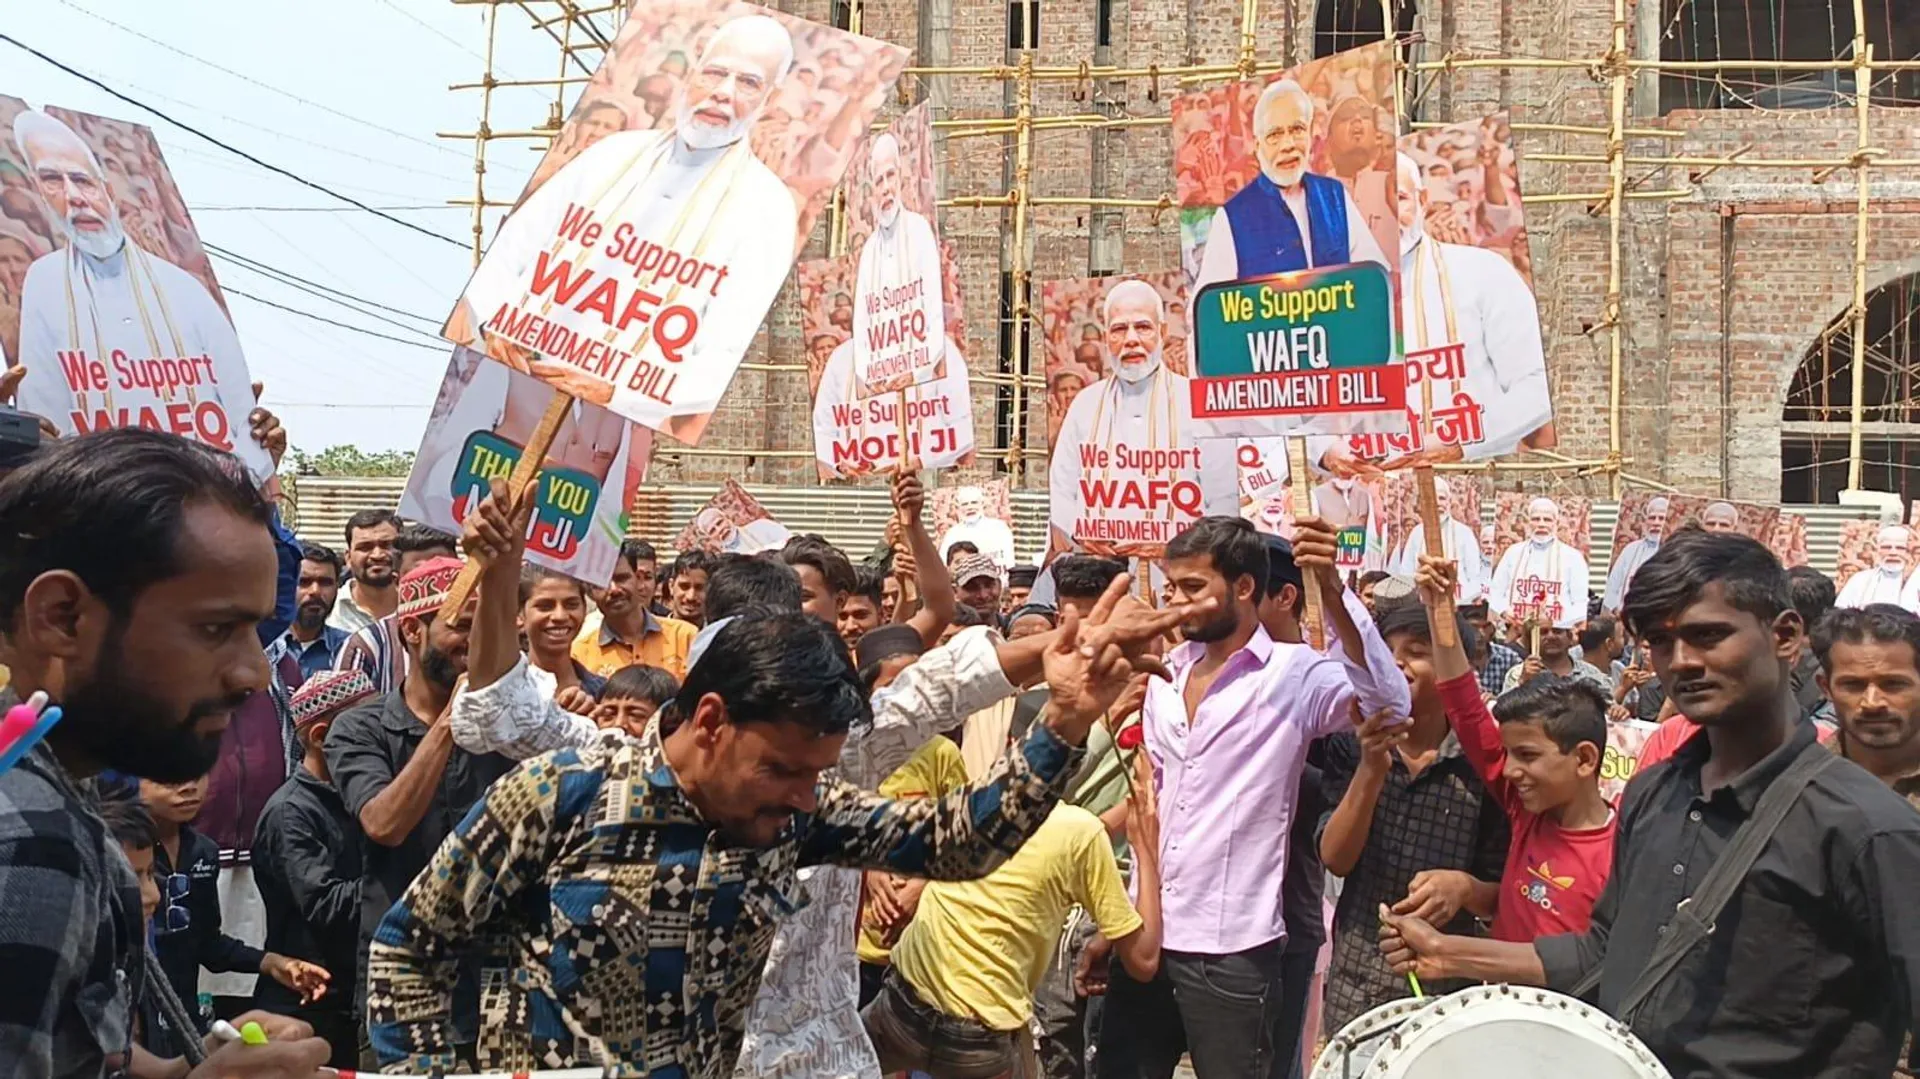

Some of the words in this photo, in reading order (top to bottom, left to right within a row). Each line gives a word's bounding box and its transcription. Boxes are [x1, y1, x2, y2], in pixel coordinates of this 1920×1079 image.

[558, 202, 602, 248] We
[605, 222, 729, 297] Support
[530, 251, 699, 363] WAFQ
[866, 292, 880, 314] We
[883, 274, 924, 312] Support
[1220, 290, 1254, 323] We
[1260, 280, 1355, 324] Support
[867, 308, 926, 352] WAFQ
[1247, 325, 1329, 373] WAFQ
[57, 350, 109, 393] We
[111, 349, 218, 398] Support
[487, 302, 633, 382] AMENDMENT
[627, 360, 679, 406] BILL
[1205, 374, 1331, 411] AMENDMENT
[1338, 371, 1386, 405] BILL
[832, 403, 862, 427] We
[1431, 392, 1484, 444] जी
[931, 427, 957, 453] JI
[1080, 443, 1109, 469] We
[1116, 443, 1200, 475] Support
[470, 445, 543, 481] THA
[547, 475, 590, 515] YOU
[1080, 480, 1203, 517] WAFQ
[1247, 469, 1277, 491] BILL
[542, 517, 573, 552] JI
[1075, 519, 1170, 541] AMENDMENT
[1343, 531, 1363, 546] YOU
